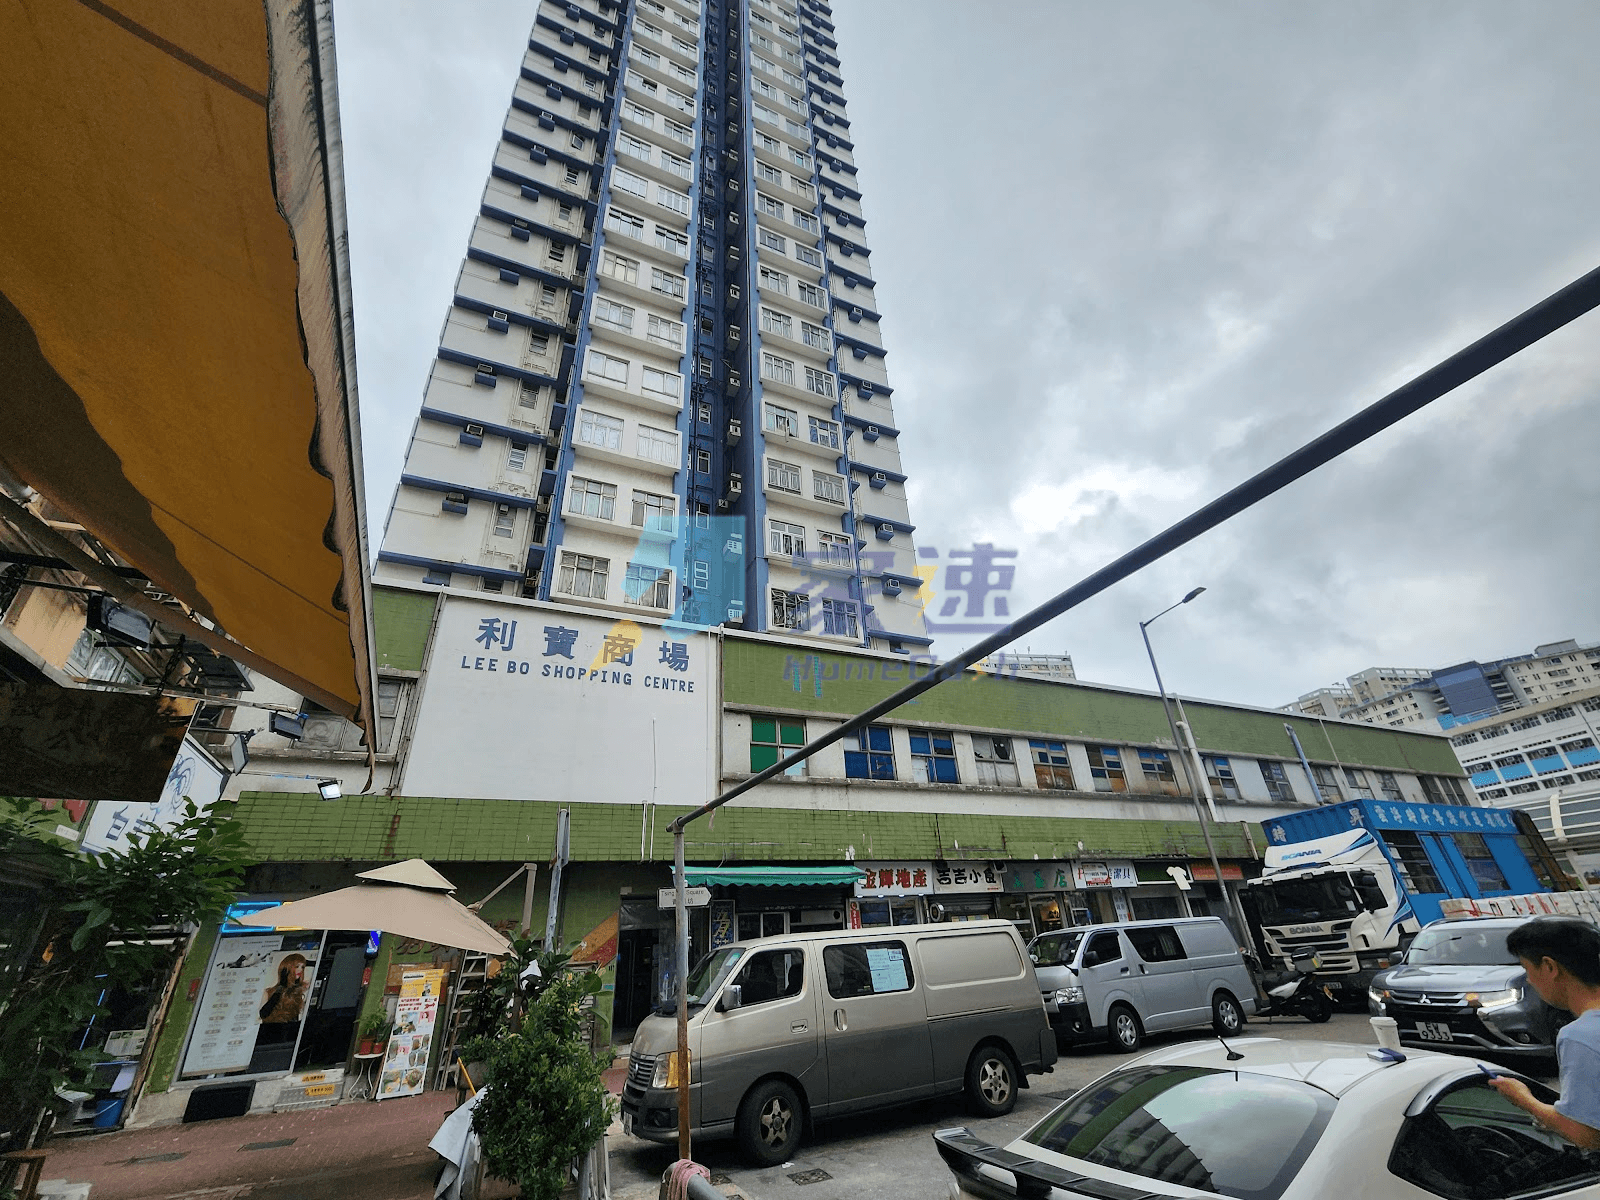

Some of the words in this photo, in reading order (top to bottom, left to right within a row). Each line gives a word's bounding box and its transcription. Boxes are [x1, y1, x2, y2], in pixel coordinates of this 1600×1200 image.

[475, 617, 690, 672] 利寶商場
[461, 655, 498, 672] LEE
[507, 660, 530, 676] BO
[541, 664, 632, 686] SHOPPING
[644, 675, 695, 693] CENTRE
[1281, 849, 1322, 861] SCANIA
[1289, 925, 1324, 935] SCANIA
